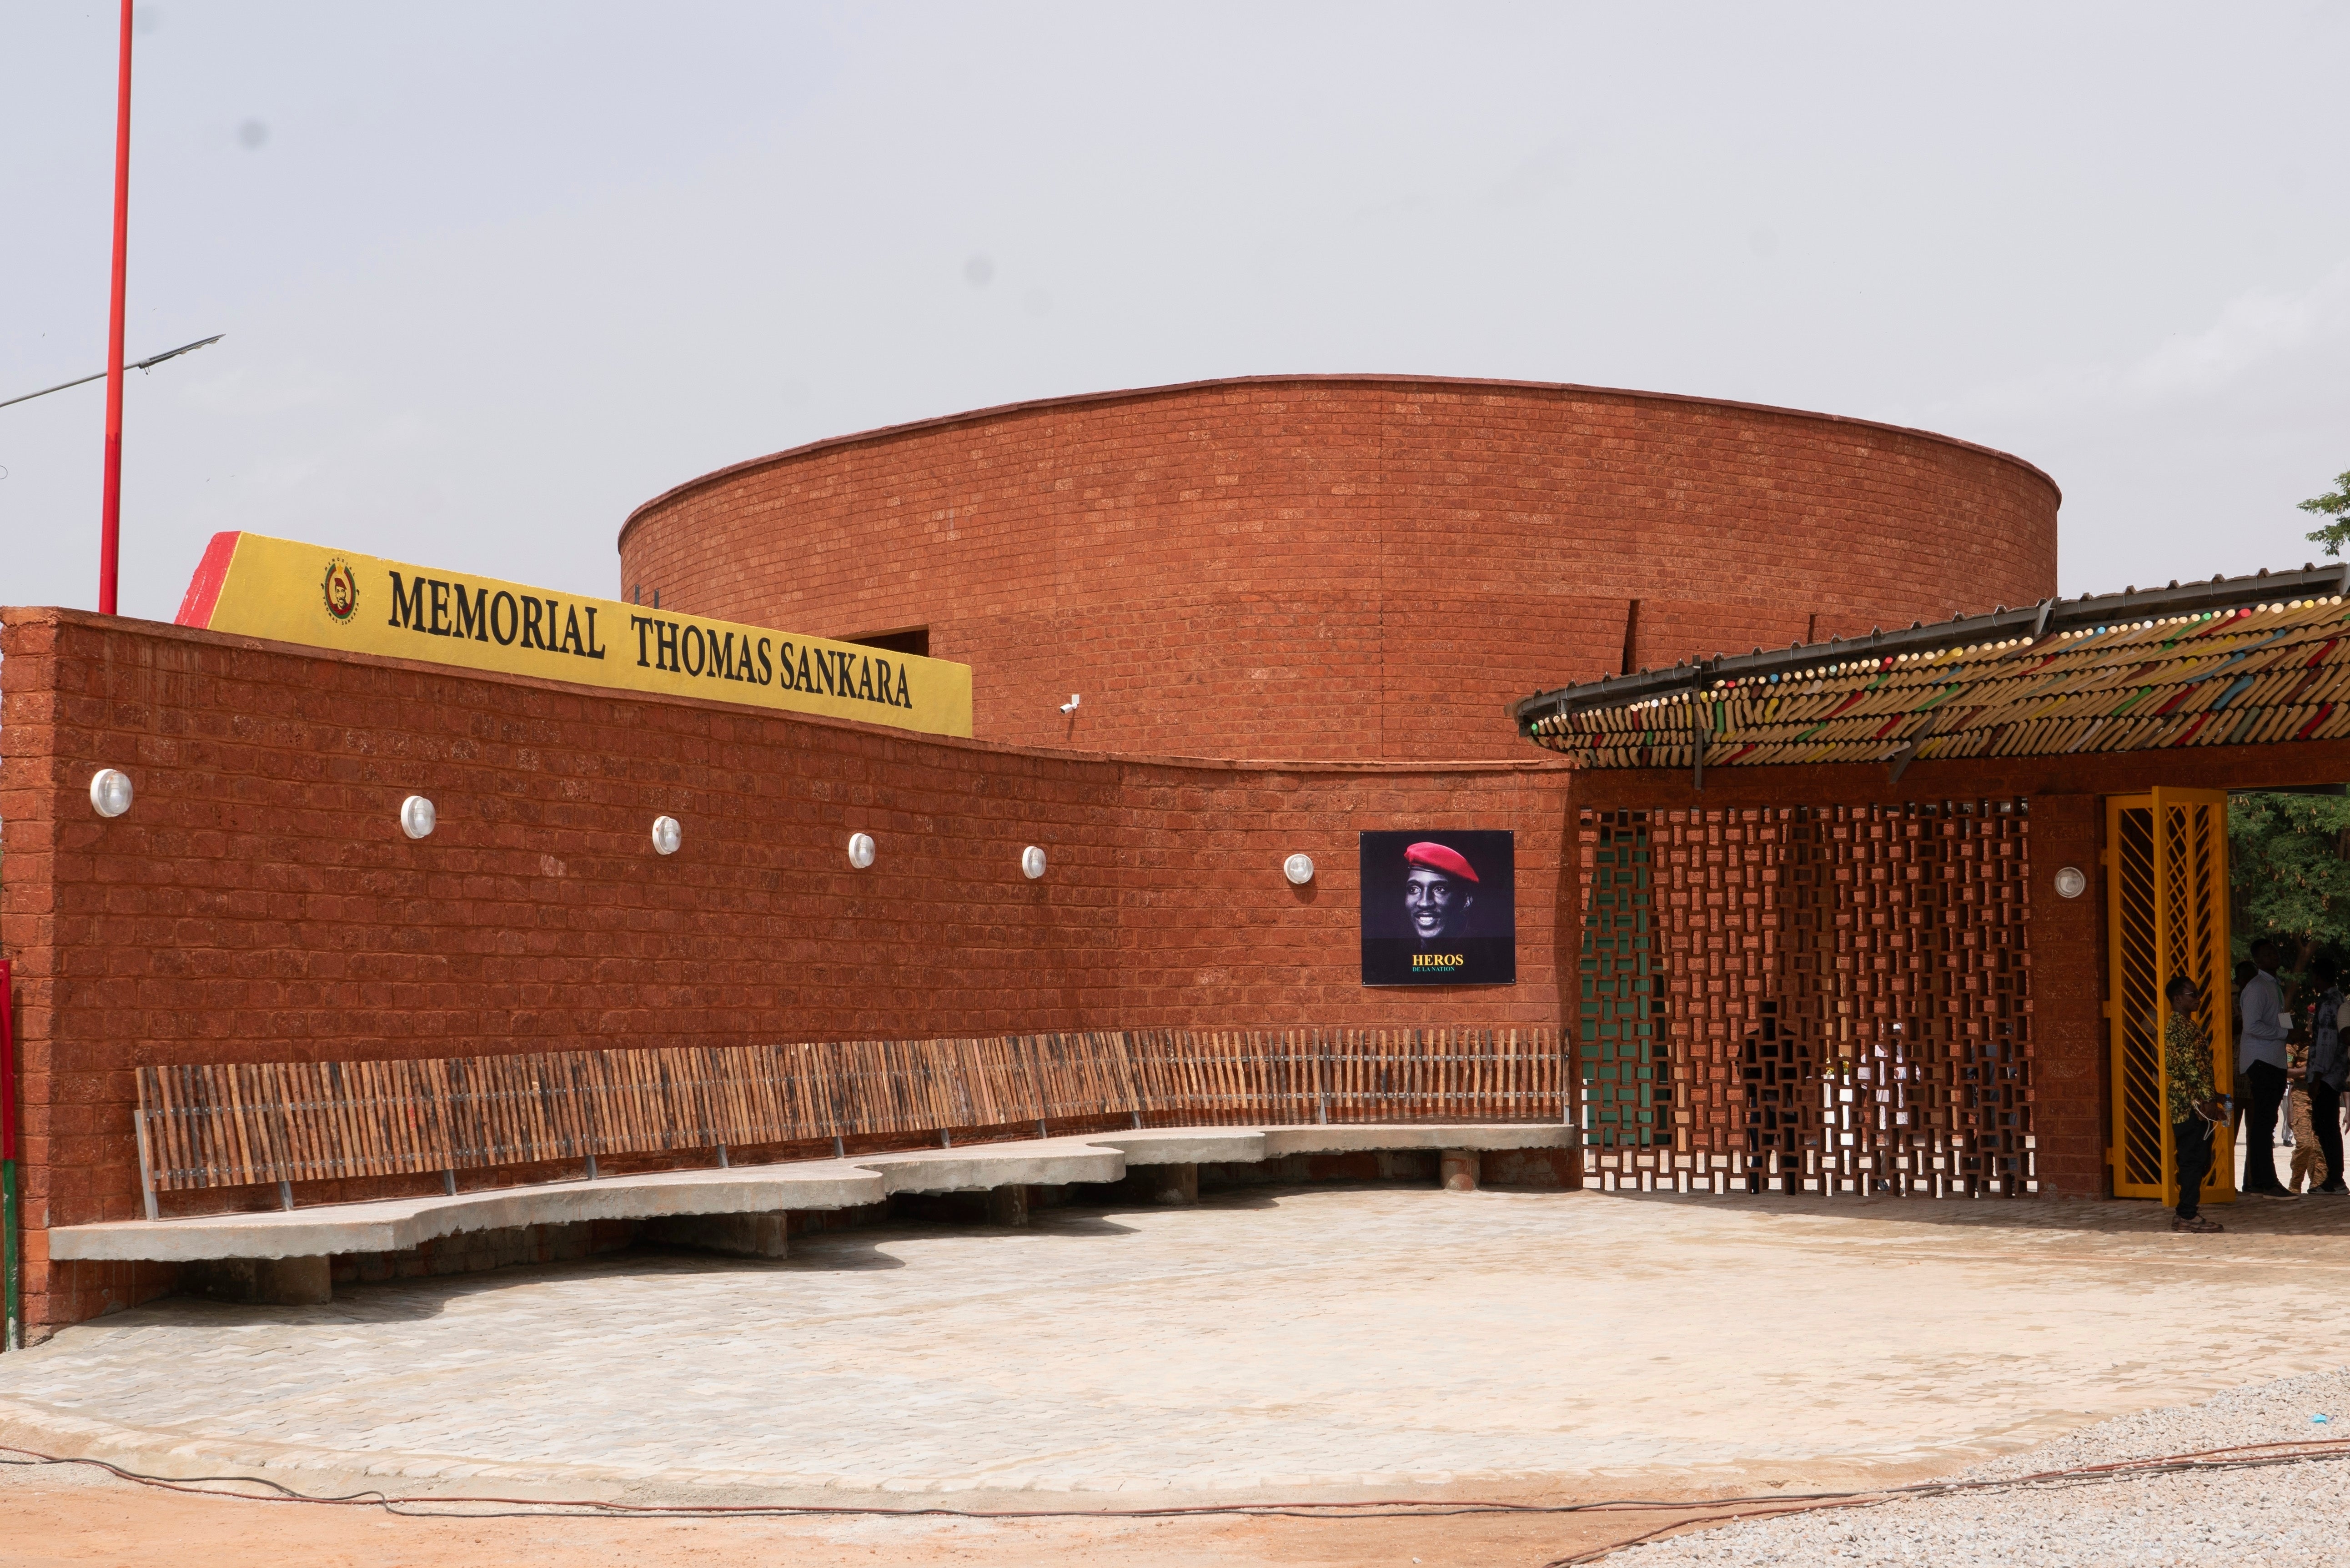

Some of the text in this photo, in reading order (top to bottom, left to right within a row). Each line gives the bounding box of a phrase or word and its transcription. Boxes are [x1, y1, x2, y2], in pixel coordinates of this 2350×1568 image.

[325, 557, 355, 576] MEMORIAL
[322, 596, 359, 625] THOMAS SANKARA
[388, 570, 912, 709] MEMORIAL THOMAS SANKARA
[1412, 954, 1463, 965] HEROS
